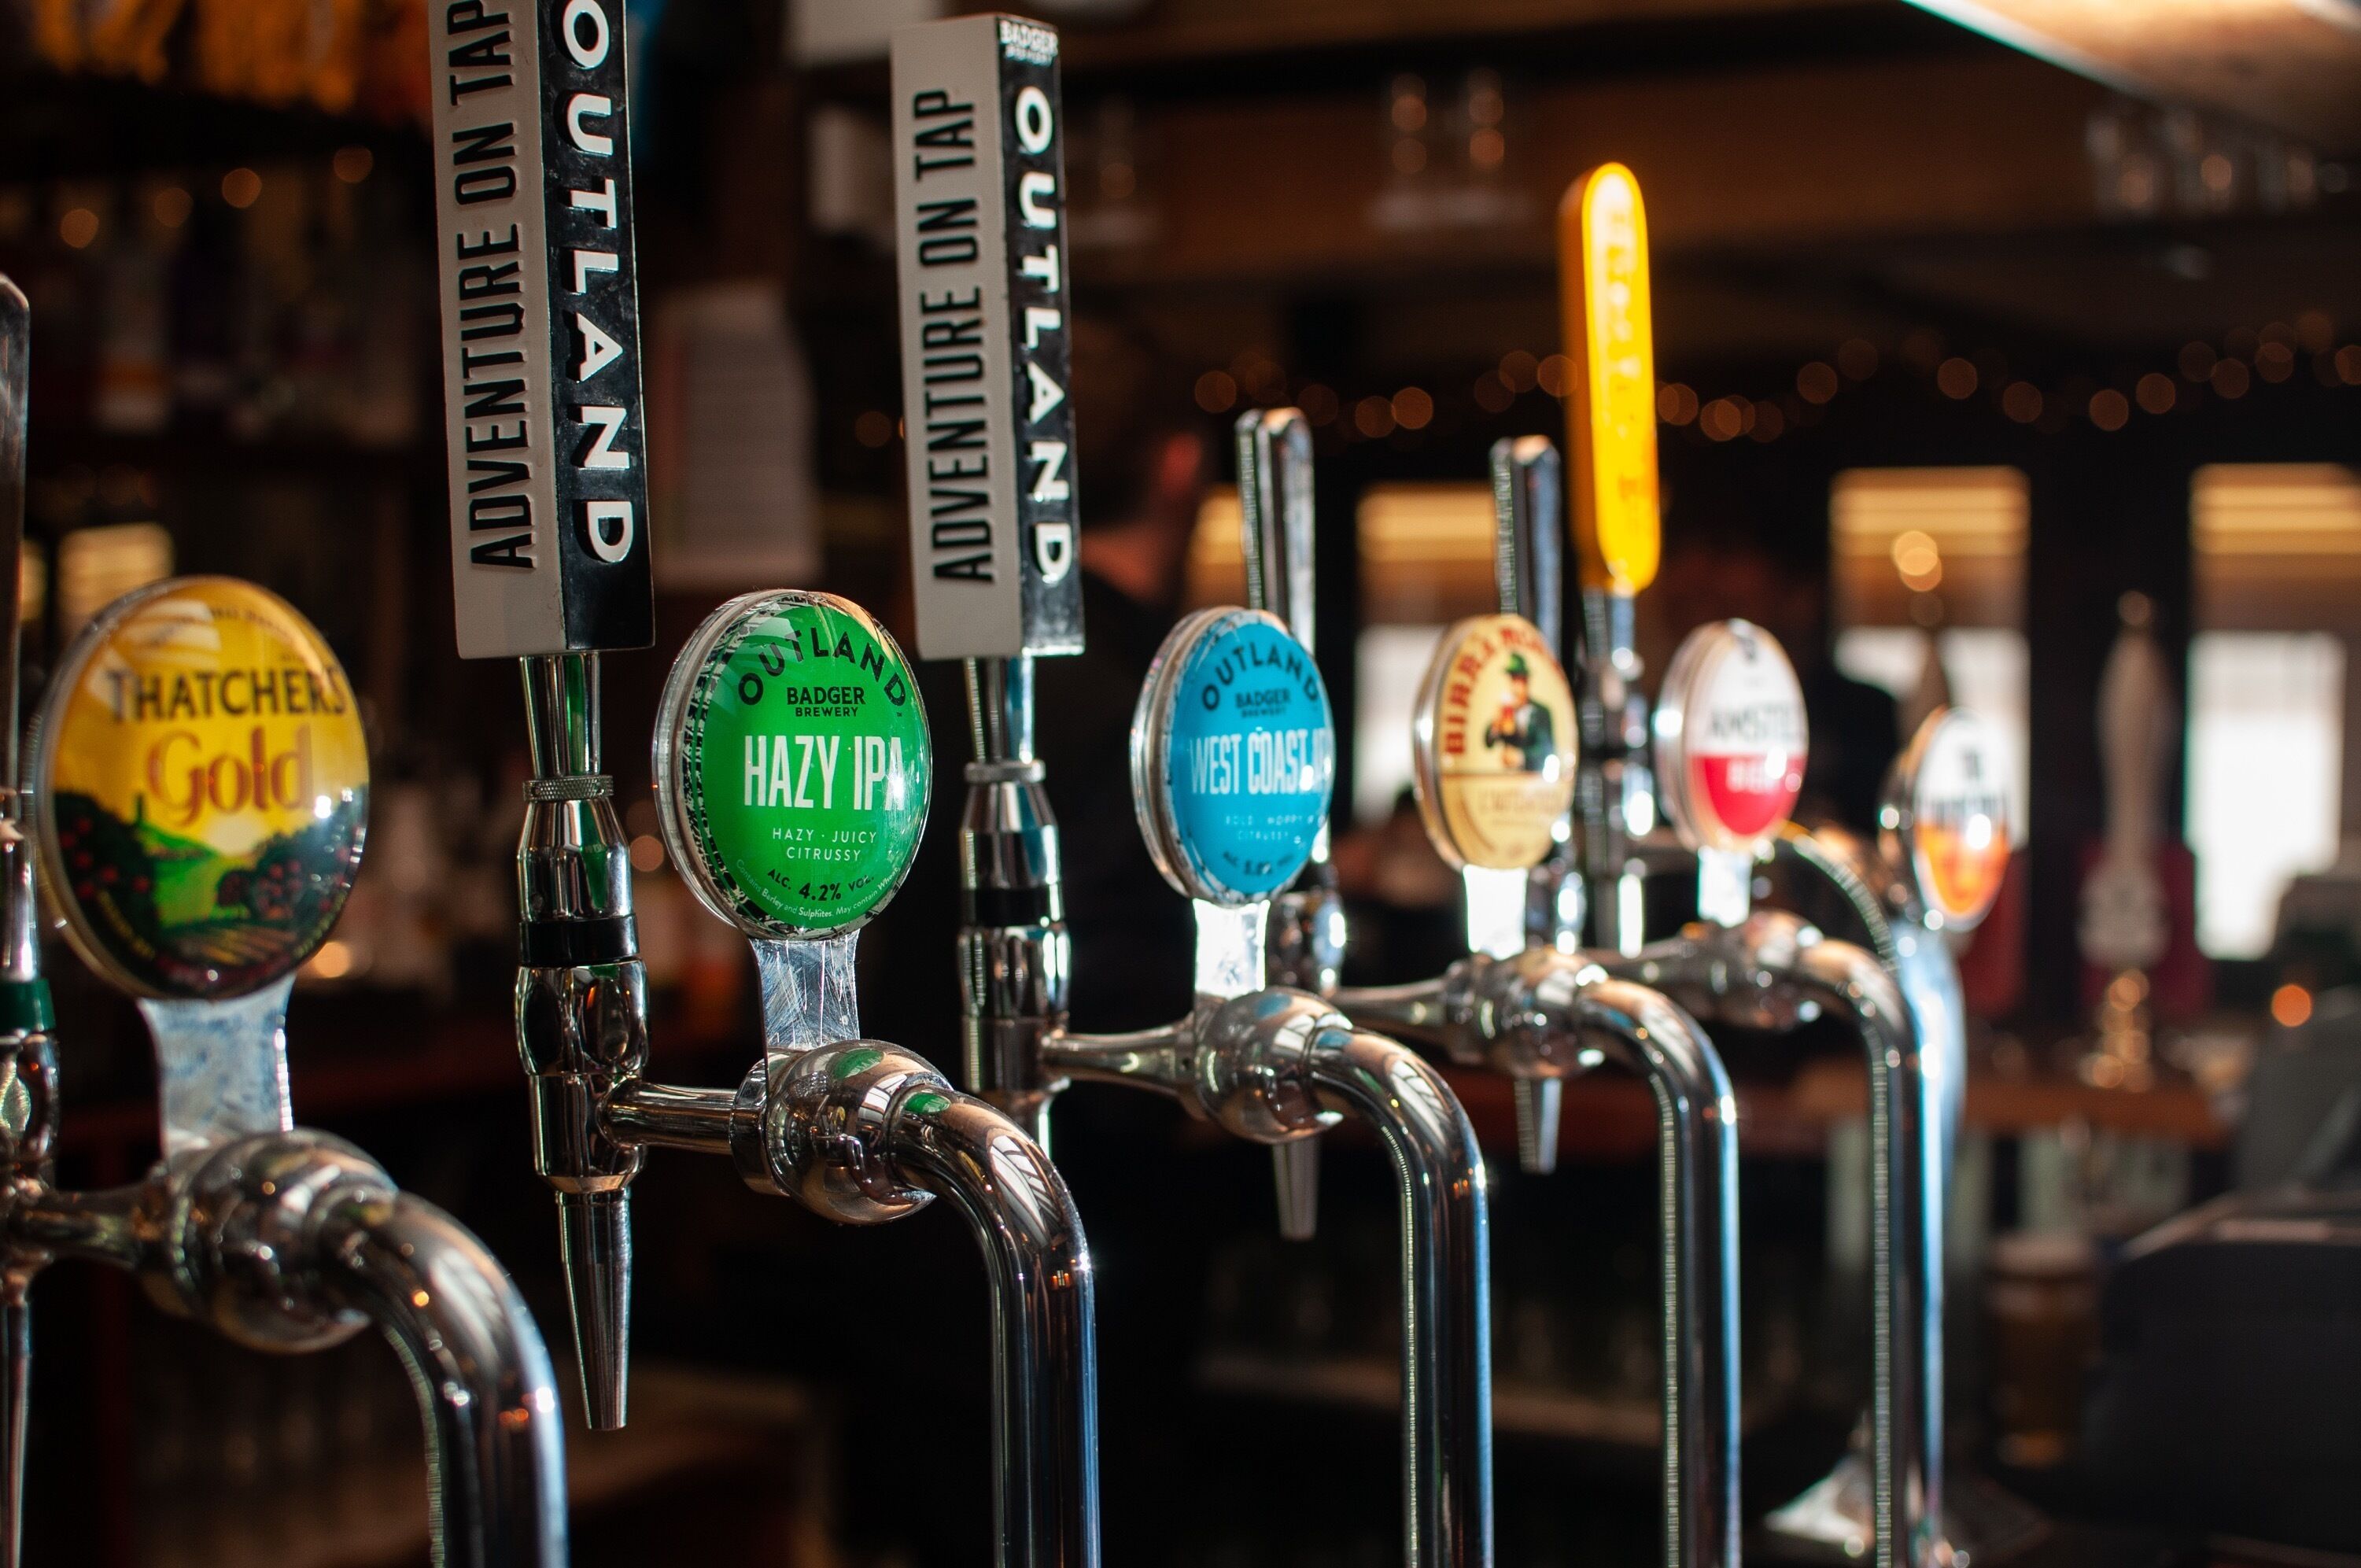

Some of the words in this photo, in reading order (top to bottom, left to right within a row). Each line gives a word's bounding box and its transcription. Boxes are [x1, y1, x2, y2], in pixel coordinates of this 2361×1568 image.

[447, 0, 514, 105] TAP
[452, 123, 518, 206] ON
[913, 89, 976, 182] TAP
[917, 198, 979, 269] ON
[561, 0, 634, 563] OUTLAND
[1015, 86, 1073, 585] OUTLAND
[456, 223, 537, 569] ADVENTURE
[920, 286, 994, 584] ADVENTURE
[107, 666, 347, 721] THATCHERS
[739, 627, 906, 706] OUTLAND
[787, 687, 865, 705] BADGER
[1202, 641, 1319, 711] OUTLAND
[1235, 688, 1291, 708] BADGER
[795, 707, 858, 717] BREWERY
[146, 725, 314, 827] Gold
[744, 736, 840, 809] HAZY
[854, 736, 905, 810] IPA
[1189, 733, 1241, 795] WEST
[1247, 729, 1311, 795] COAST
[773, 828, 814, 841] HAZY
[832, 831, 876, 843] JUICY
[787, 847, 861, 861] CITRUSSY
[762, 888, 784, 909] Barley
[784, 906, 798, 914] and
[836, 906, 851, 915] May
[853, 890, 878, 909] contain
[768, 869, 791, 890] ALC.
[799, 883, 841, 902] 4.2%
